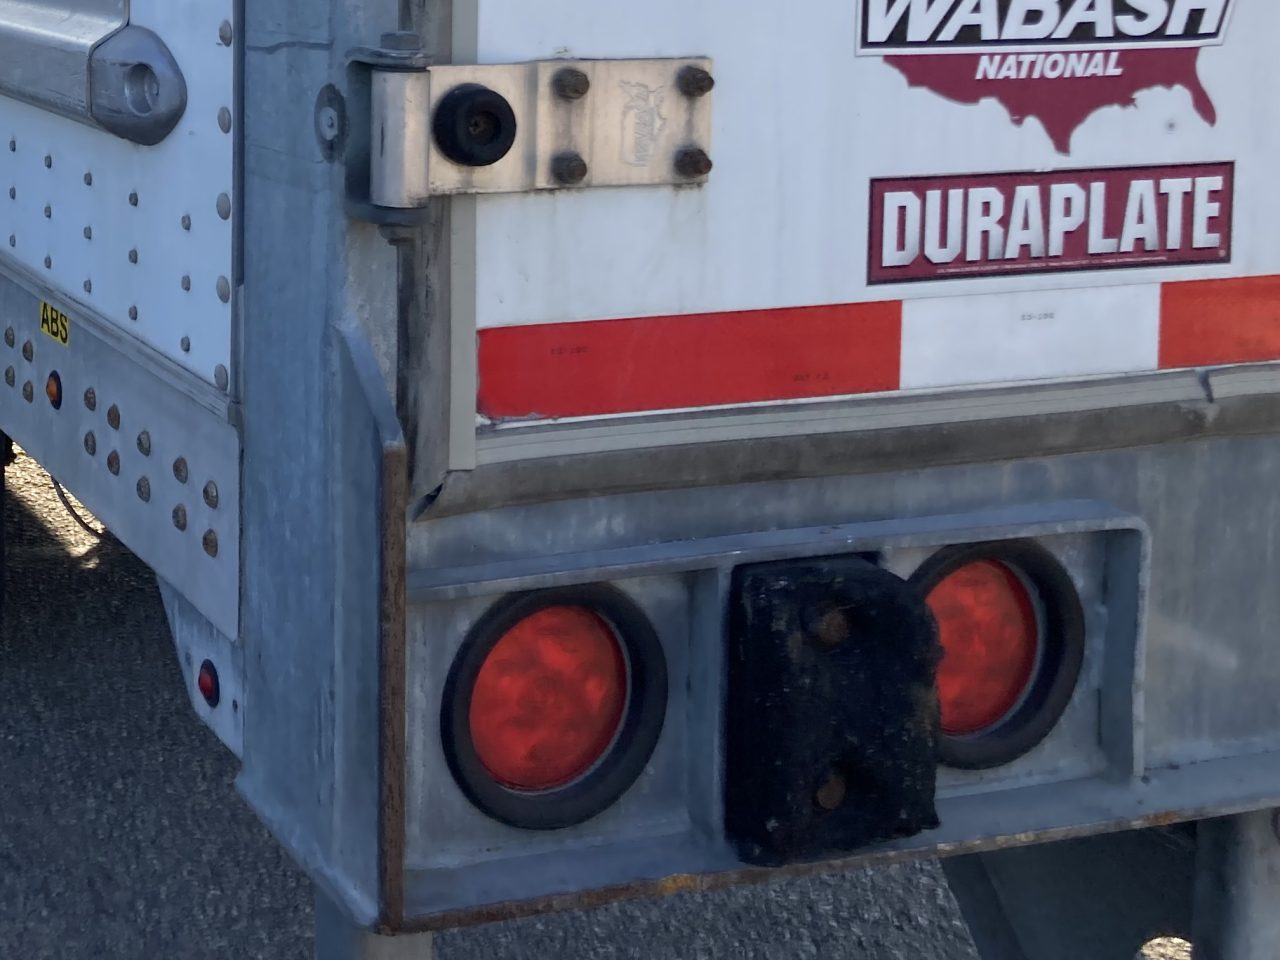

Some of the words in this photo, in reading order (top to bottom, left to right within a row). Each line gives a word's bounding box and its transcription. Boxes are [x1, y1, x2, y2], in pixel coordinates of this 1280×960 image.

[975, 51, 1124, 80] NATIONAL
[881, 175, 1223, 268] DURAPLATE
[41, 301, 68, 344] ABS
